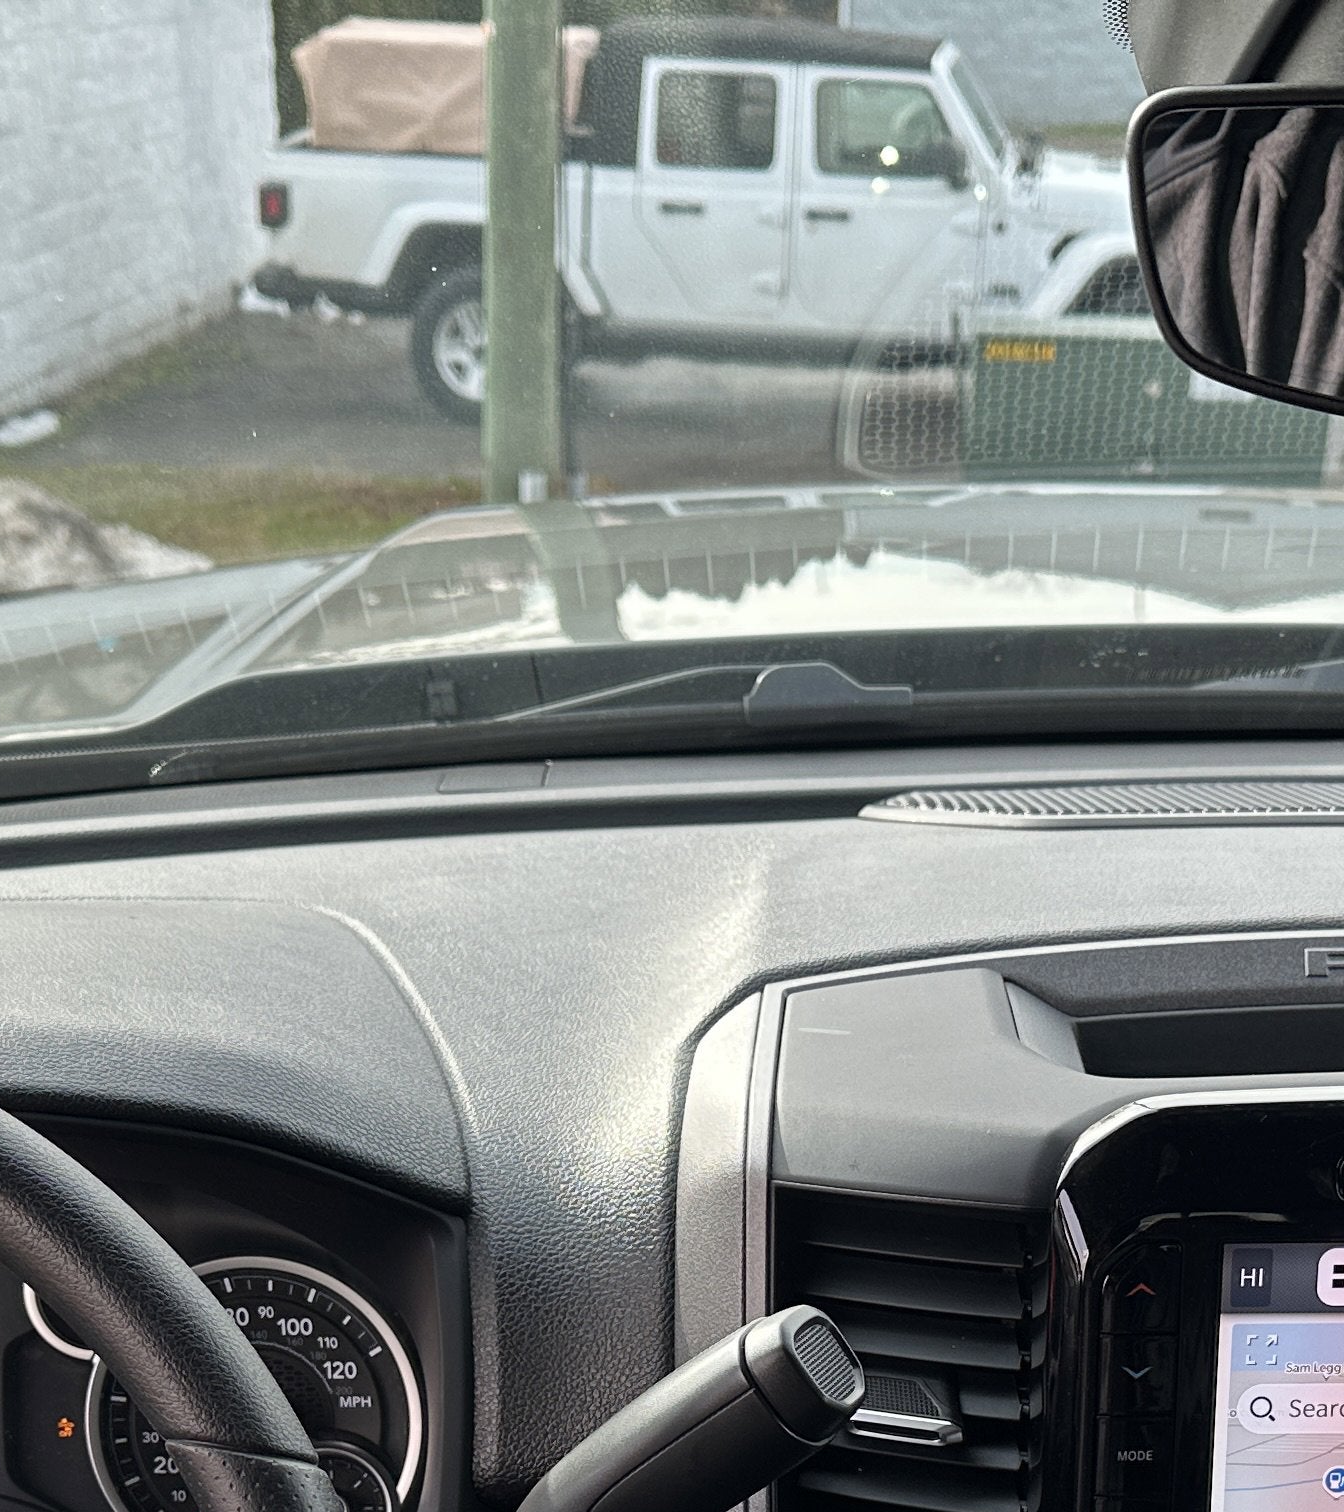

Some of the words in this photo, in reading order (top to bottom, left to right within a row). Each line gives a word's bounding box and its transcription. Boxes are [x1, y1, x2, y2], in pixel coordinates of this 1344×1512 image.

[1240, 1268, 1264, 1287] HI
[258, 1306, 275, 1319] 90
[276, 1318, 314, 1336] 100
[317, 1337, 338, 1349] 110
[323, 1361, 357, 1380] 120
[1286, 1362, 1311, 1373] Sam
[1314, 1362, 1340, 1376] Legg
[340, 1396, 372, 1408] MPH
[142, 1432, 159, 1444] 30
[1117, 1451, 1153, 1461] MODE
[153, 1456, 178, 1475] 20
[171, 1490, 187, 1502] 10
